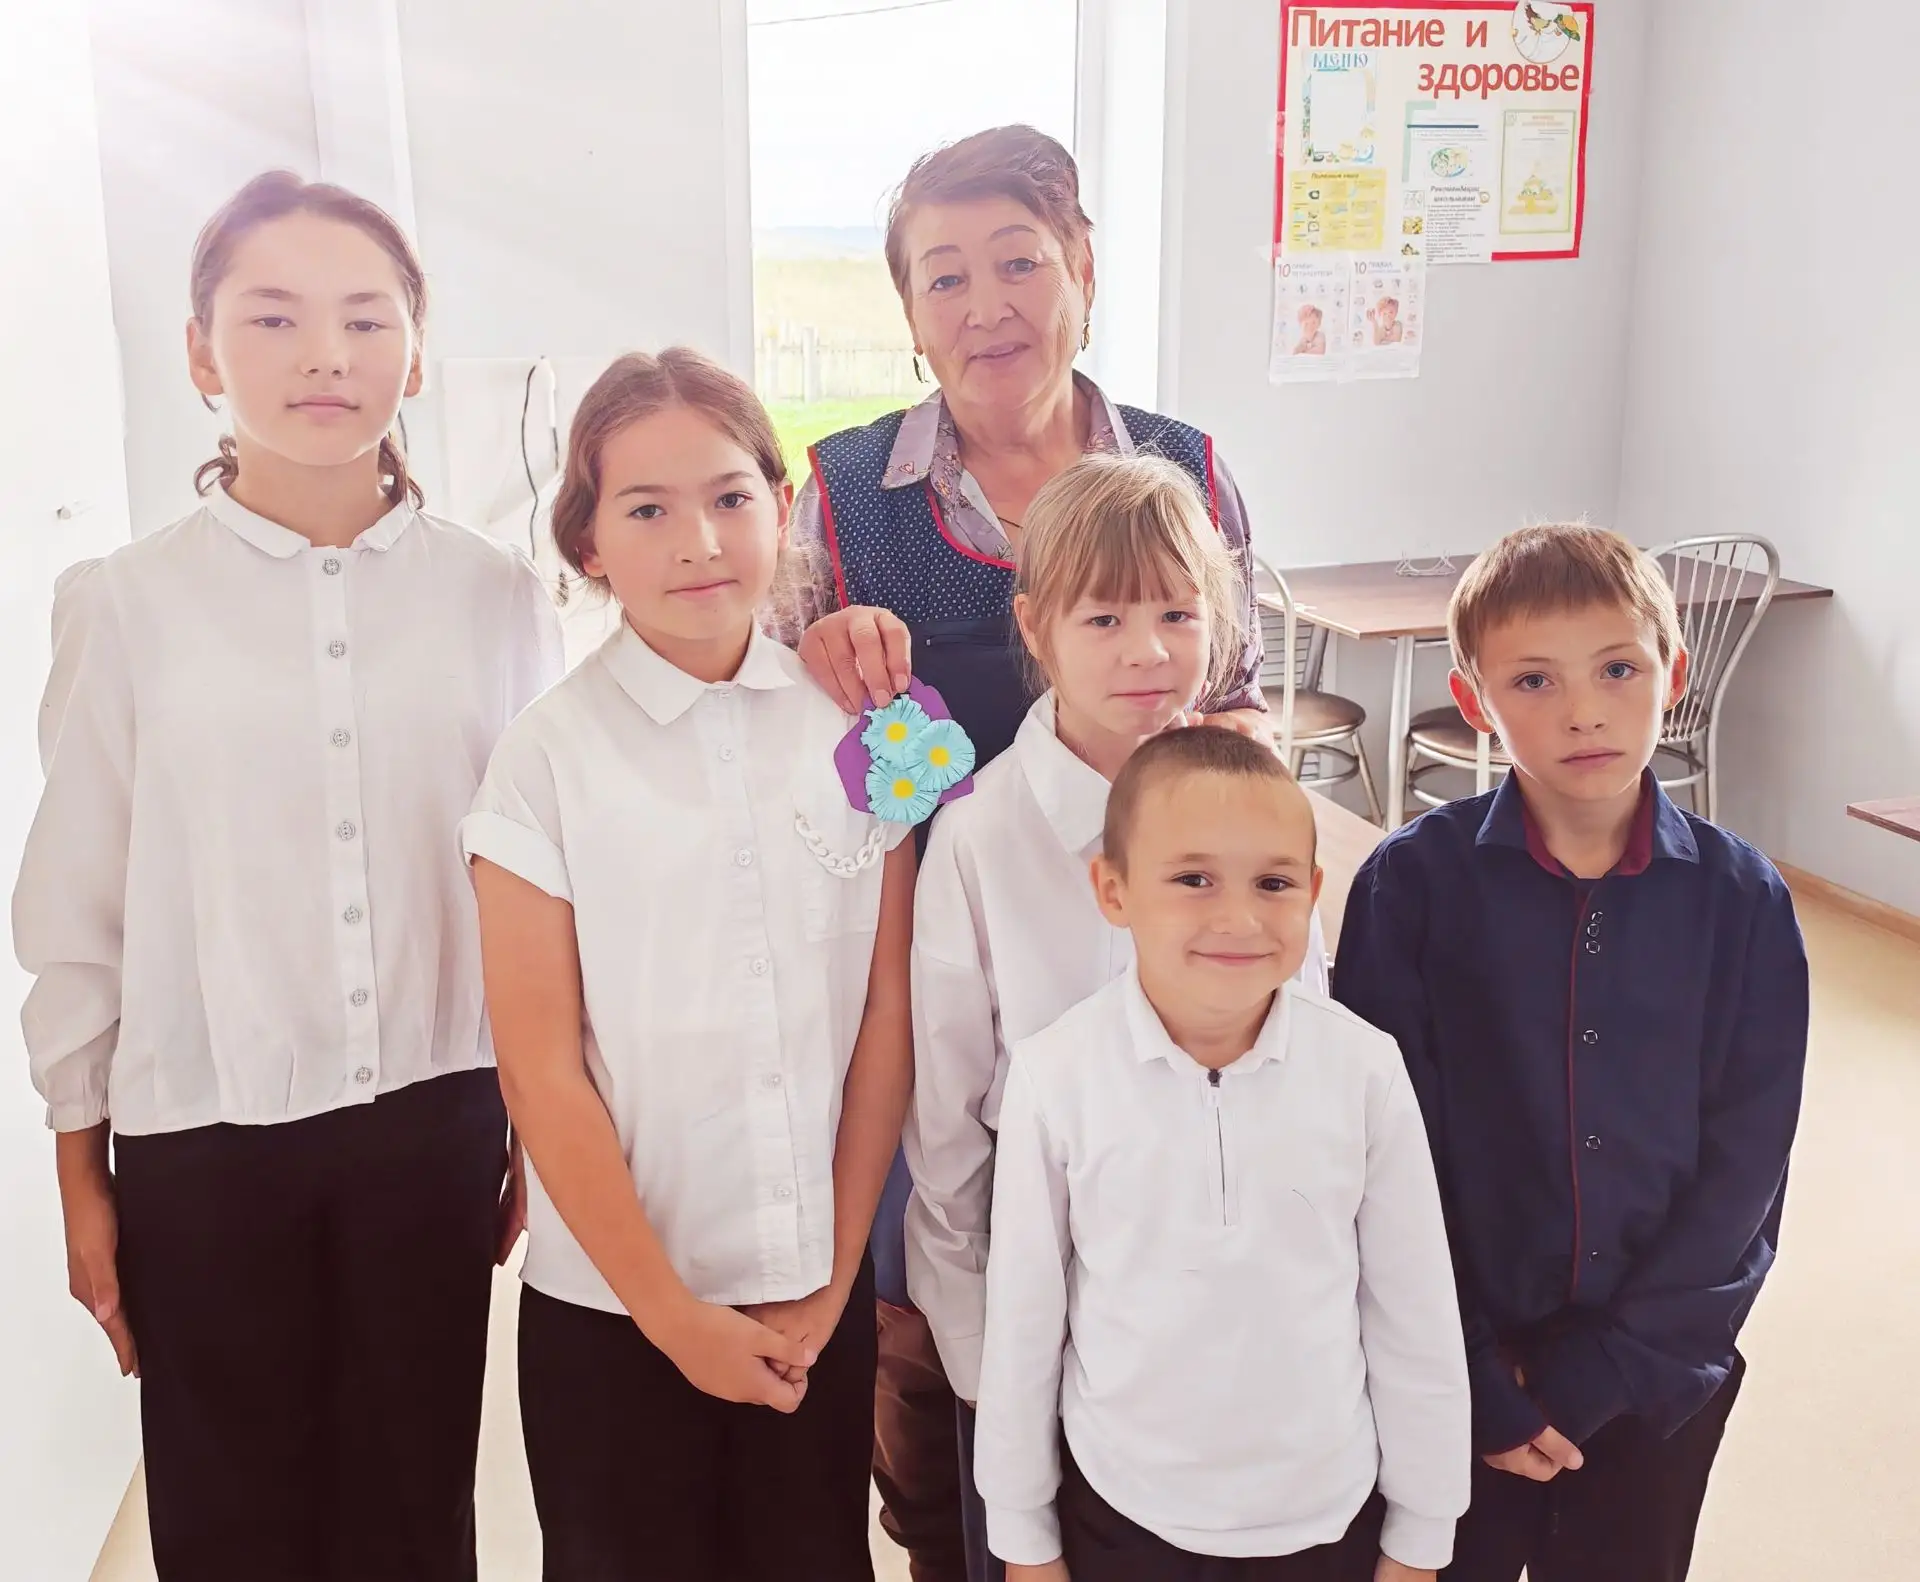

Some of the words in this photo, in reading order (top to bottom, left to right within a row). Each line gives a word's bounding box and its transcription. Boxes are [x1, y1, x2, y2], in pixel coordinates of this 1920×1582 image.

[1291, 9, 1445, 48] Питание
[1466, 20, 1488, 48] и
[1417, 63, 1580, 100] здоровье
[1277, 263, 1291, 278] 10
[1354, 261, 1367, 275] 10
